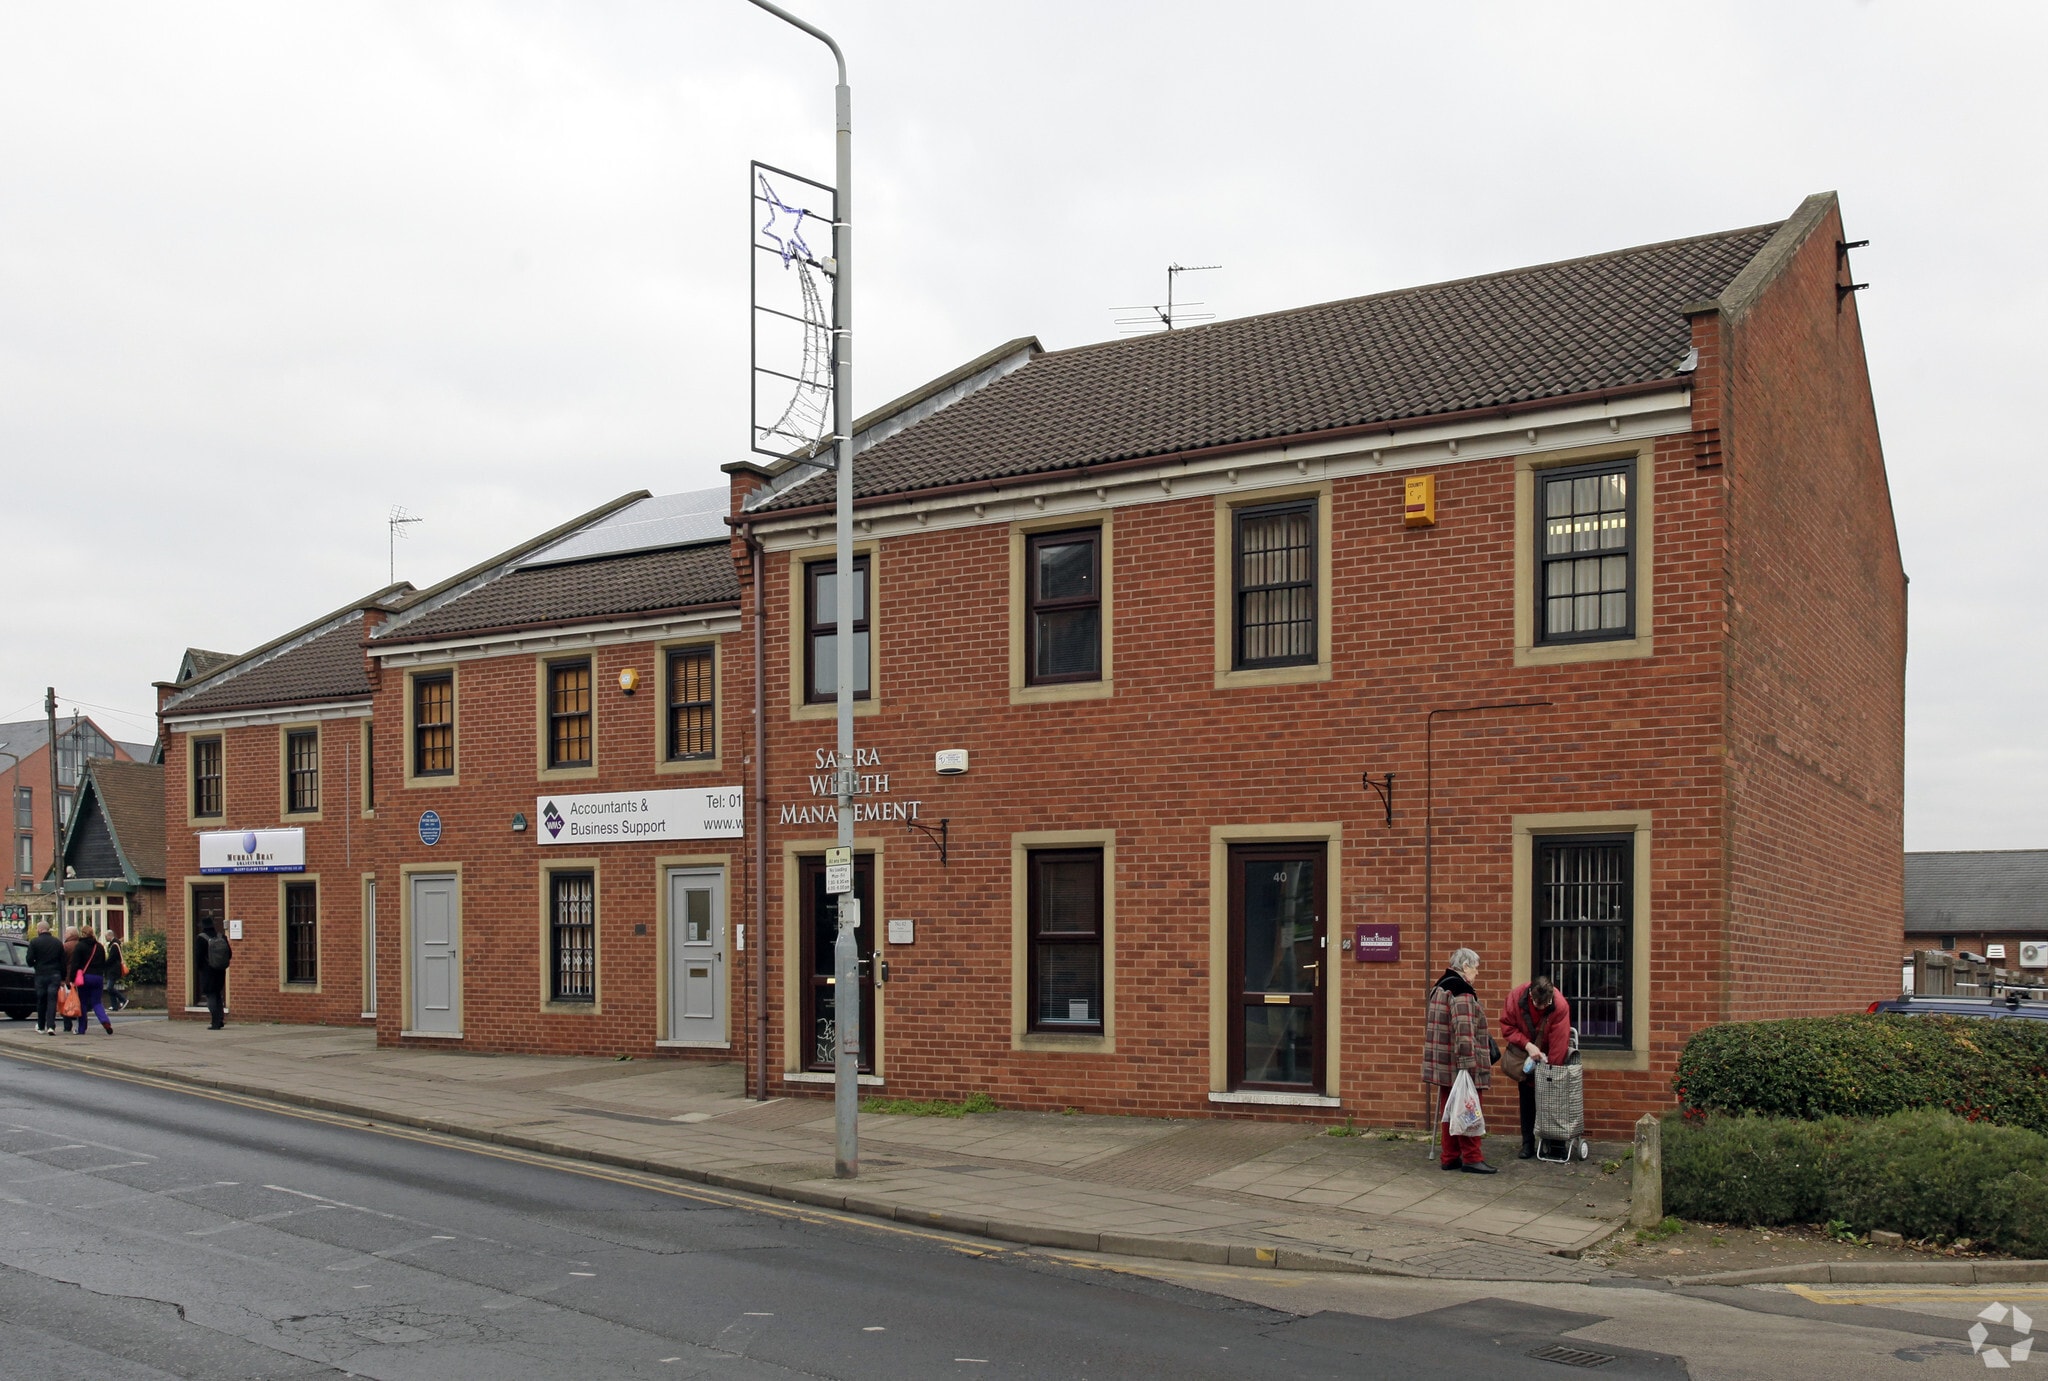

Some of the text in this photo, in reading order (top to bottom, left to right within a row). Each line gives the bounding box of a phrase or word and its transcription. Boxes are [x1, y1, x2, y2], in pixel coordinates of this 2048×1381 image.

[815, 747, 881, 769] SARA
[570, 798, 649, 815] Accountants &
[705, 793, 742, 808] Tel: 01
[779, 801, 921, 825] MANAEMENT
[571, 819, 666, 837] Business Support
[227, 853, 274, 861] MURRAY BRAY
[1273, 872, 1287, 882] 40
